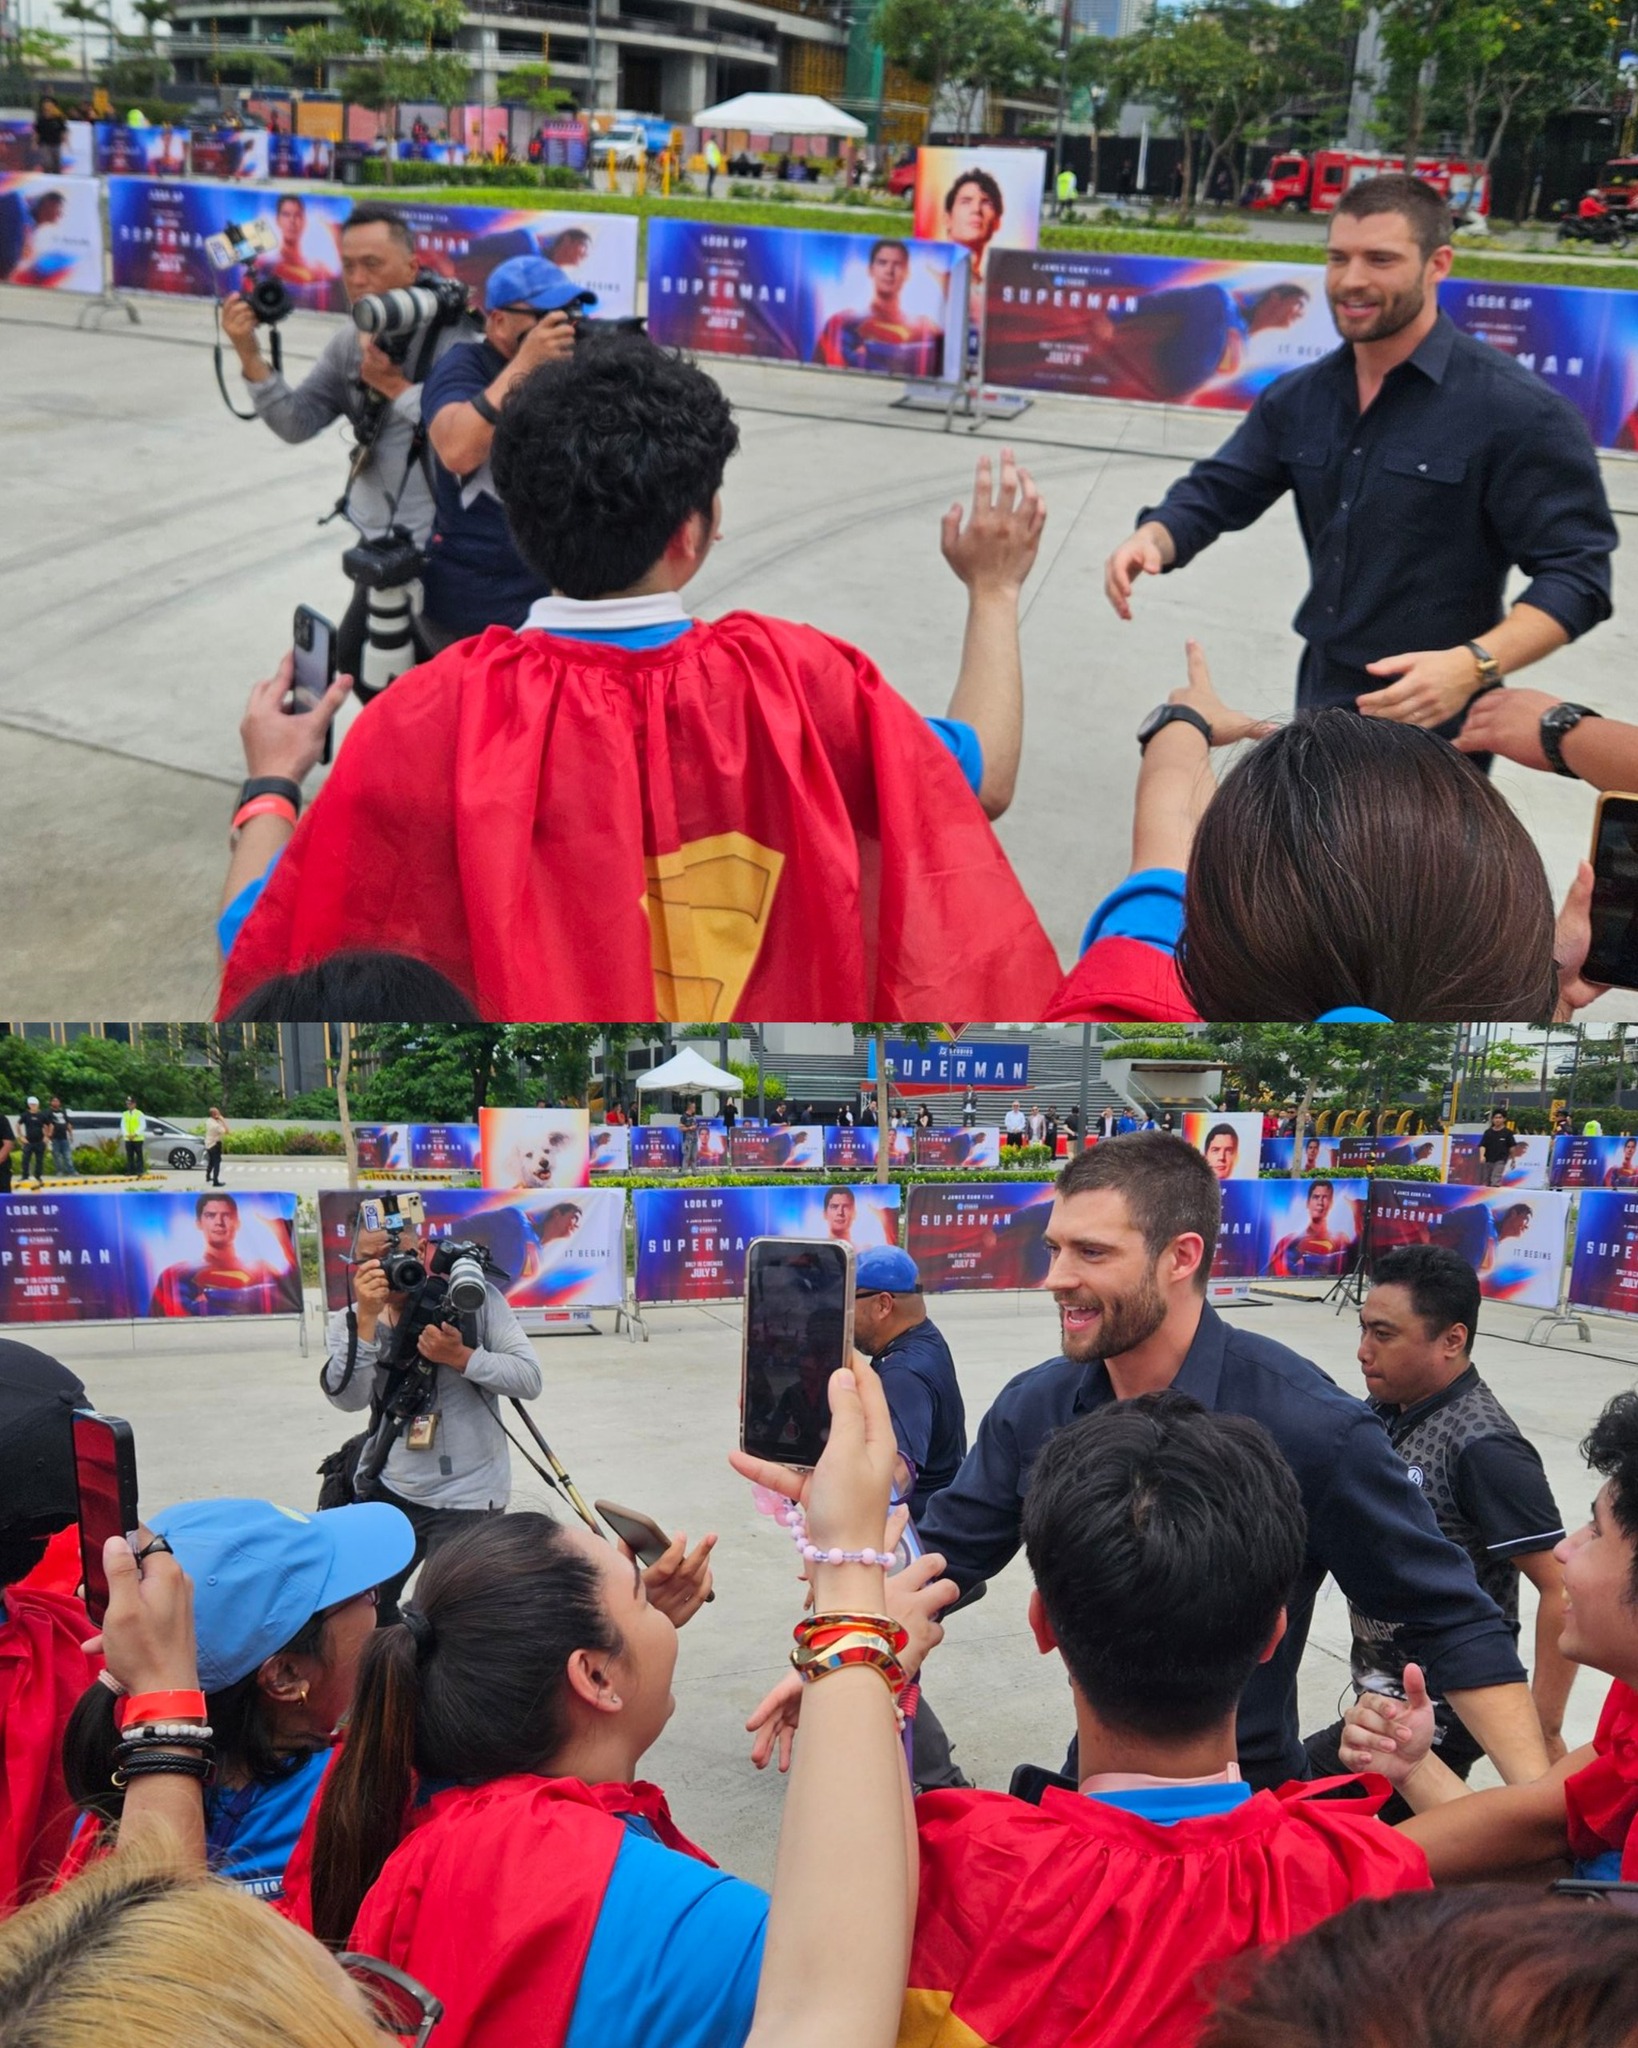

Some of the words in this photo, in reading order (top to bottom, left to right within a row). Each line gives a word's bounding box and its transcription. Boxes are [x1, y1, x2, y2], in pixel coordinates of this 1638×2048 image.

[661, 275, 787, 303] SUPERMAN
[1002, 286, 1139, 313] SUPERMAN
[884, 1058, 1023, 1080] SUPERMAN
[6, 1205, 37, 1216] LOOK
[42, 1205, 59, 1216] UP
[684, 1199, 707, 1209] LOOK
[711, 1199, 723, 1208] UP
[920, 1213, 1012, 1227] SUPERMAN
[1377, 1206, 1443, 1224] SUPERMAN
[648, 1237, 755, 1253] SUPERMA
[1586, 1241, 1638, 1260] SUPE
[952, 1259, 969, 1269] JULY
[690, 1268, 711, 1278] JULY
[711, 1267, 718, 1278] 9
[23, 1285, 49, 1297] JULY
[50, 1284, 59, 1296] 9
